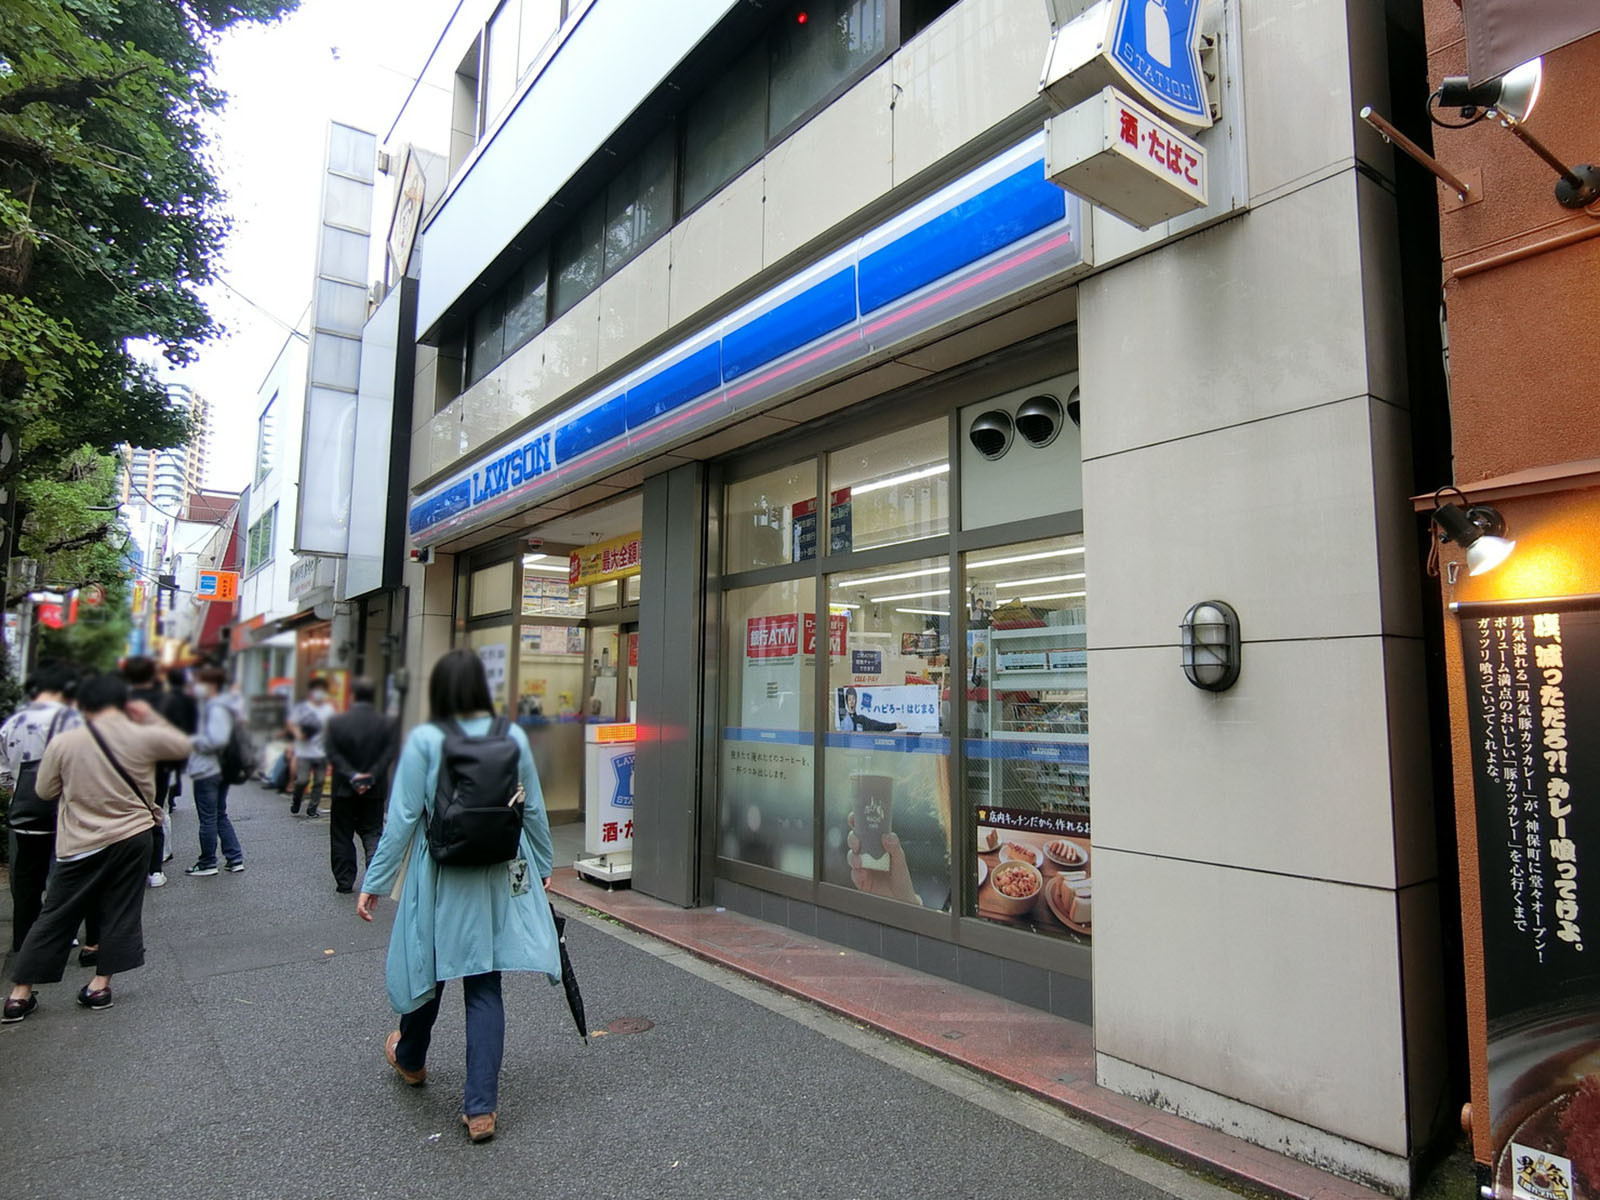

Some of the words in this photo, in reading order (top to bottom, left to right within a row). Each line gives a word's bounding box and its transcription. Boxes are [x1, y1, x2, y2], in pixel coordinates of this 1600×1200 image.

[1124, 43, 1193, 101] STATION
[1120, 108, 1199, 187] 酒・たばこ
[472, 432, 552, 505] LAWSON
[750, 627, 796, 646] 銀行ATM
